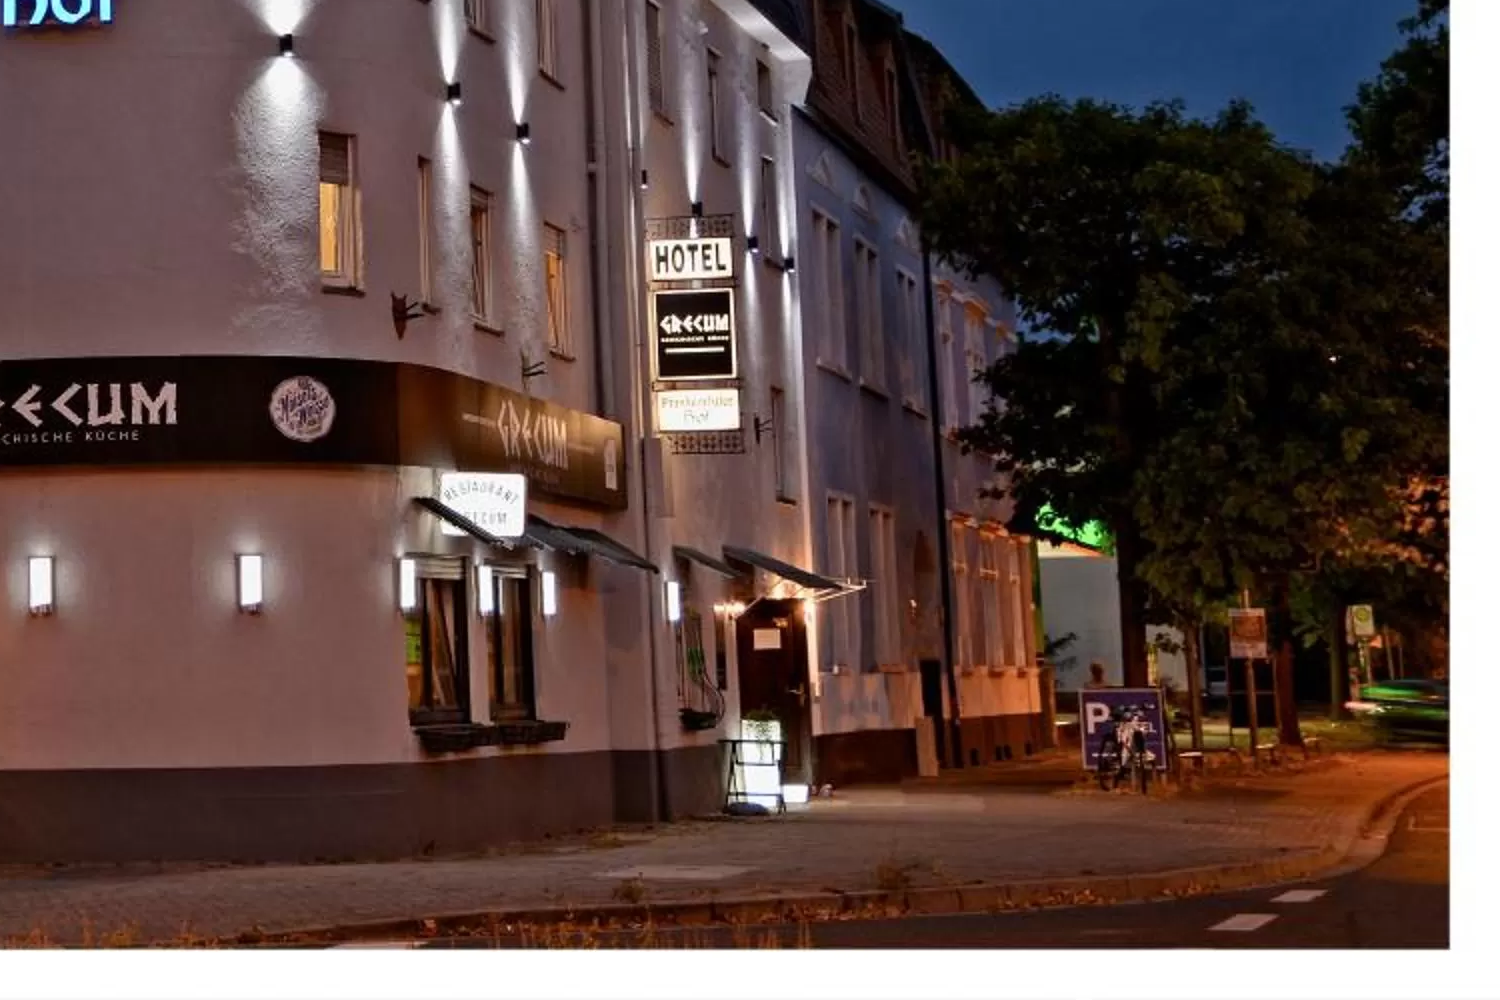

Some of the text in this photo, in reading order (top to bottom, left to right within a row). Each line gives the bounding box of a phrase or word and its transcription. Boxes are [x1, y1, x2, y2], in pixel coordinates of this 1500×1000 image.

[655, 243, 727, 274] HOTEL
[659, 313, 729, 334] GRECUM
[496, 399, 569, 471] GRECUM
[443, 480, 519, 505] RESTAURANT
[1085, 702, 1111, 734] P
